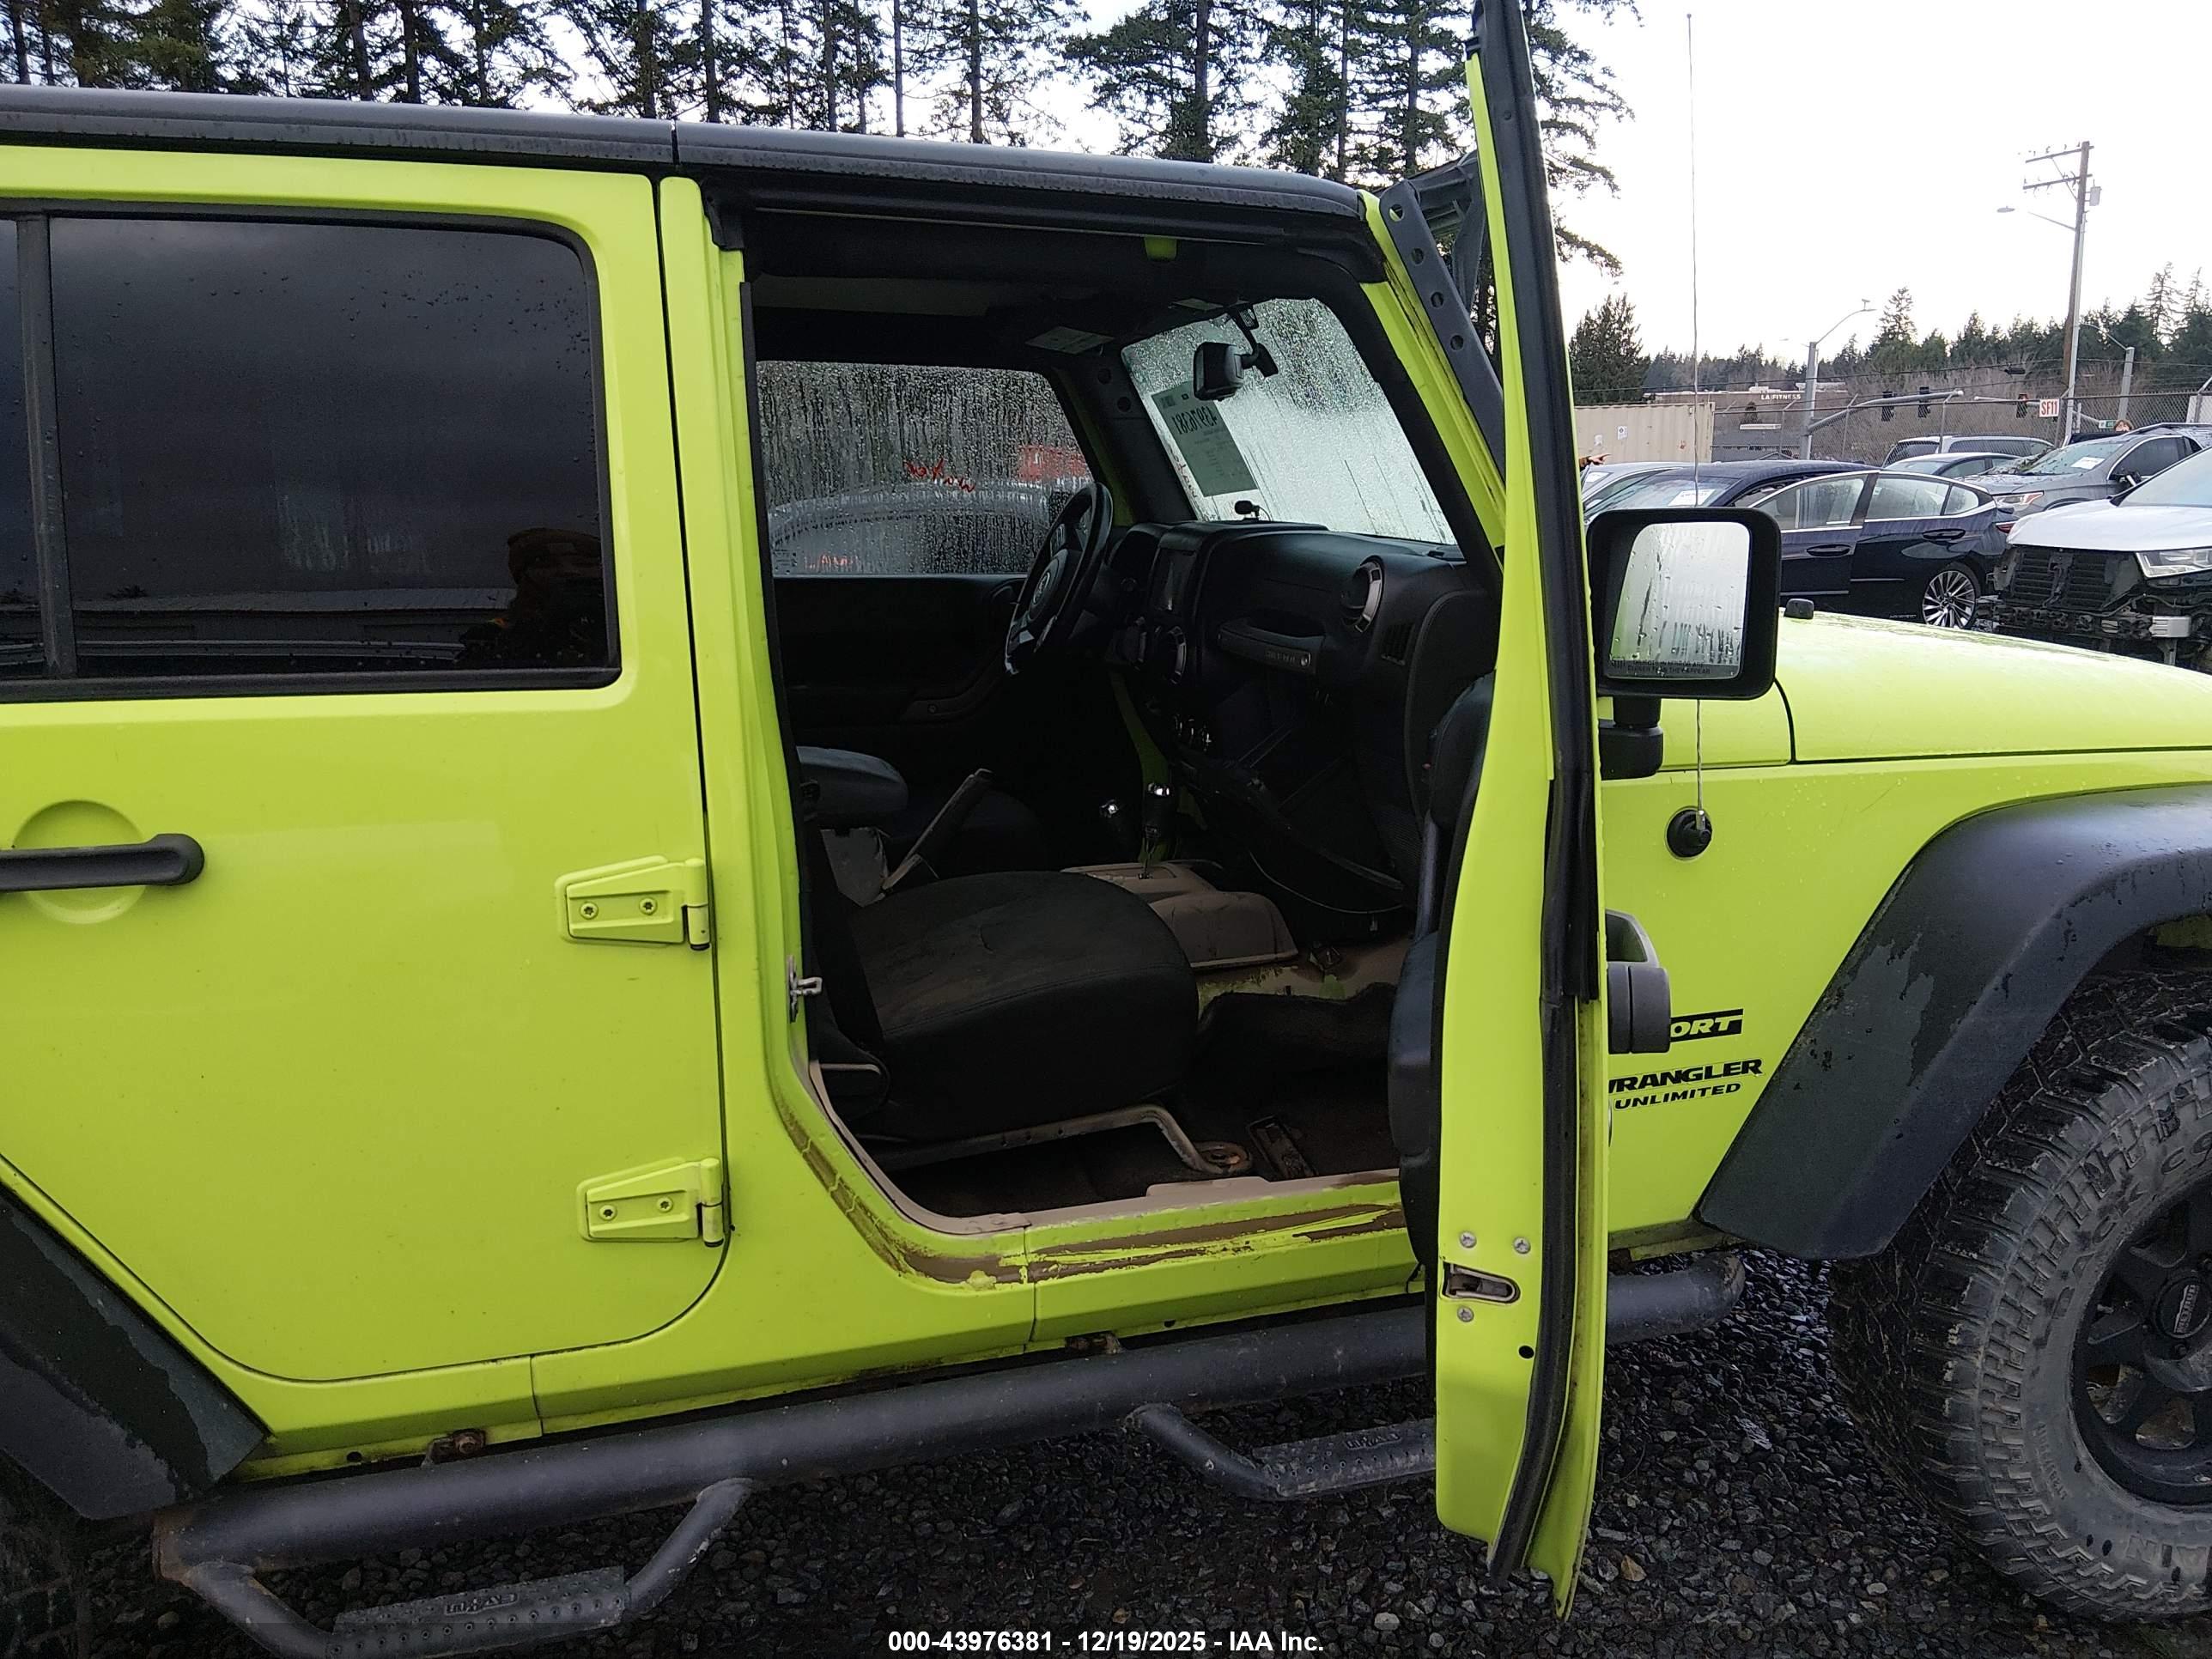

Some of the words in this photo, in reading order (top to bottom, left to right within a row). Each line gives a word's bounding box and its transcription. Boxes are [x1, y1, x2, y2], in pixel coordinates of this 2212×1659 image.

[2041, 401, 2057, 415] SF11
[1670, 1017, 1737, 1038] ORT
[1614, 1082, 1741, 1109] UNLIMITED
